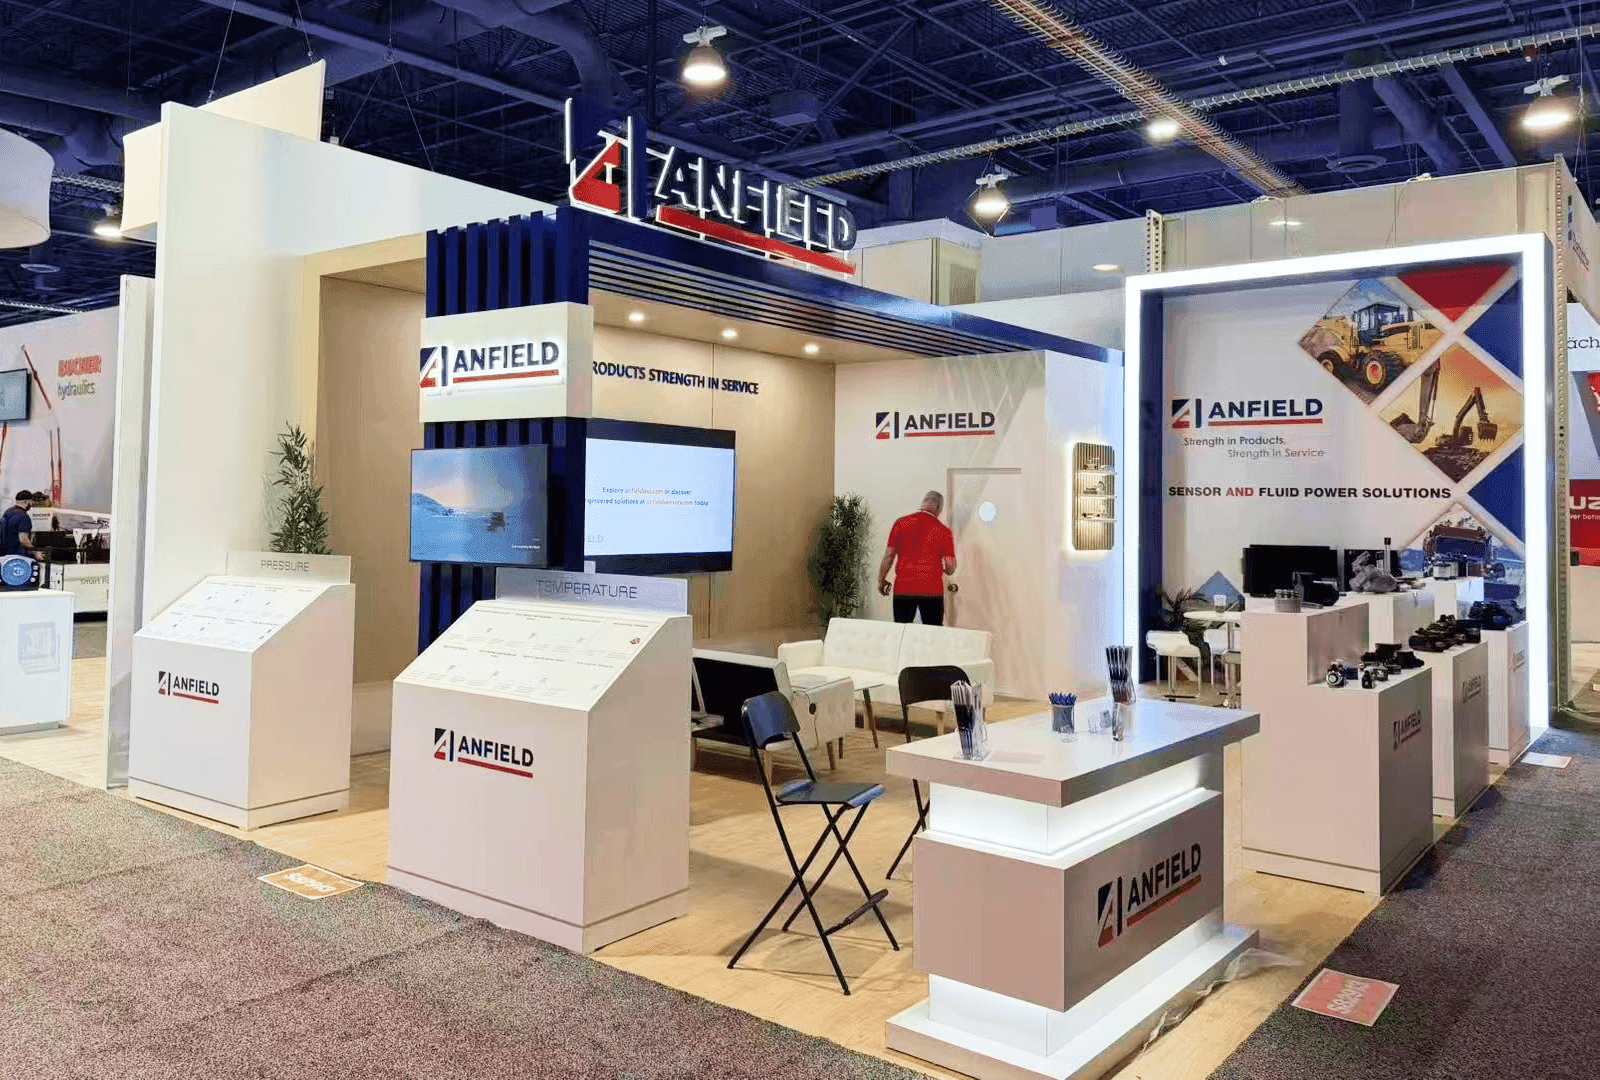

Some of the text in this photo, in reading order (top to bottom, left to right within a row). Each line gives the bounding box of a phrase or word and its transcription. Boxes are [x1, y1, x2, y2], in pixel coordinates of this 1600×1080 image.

[650, 146, 857, 252] ANFIELD
[453, 341, 560, 373] ANFIELD
[649, 368, 705, 388] STRENGTH
[708, 376, 719, 390] IN
[721, 378, 759, 395] SERVICE
[1208, 398, 1323, 418] ANFIELD
[904, 411, 996, 430] ANFIELD
[1227, 437, 1236, 445] in
[1228, 449, 1269, 460] Strength
[1284, 448, 1325, 457] Service
[1168, 487, 1451, 498] SENSOR AND FLUID POWER SOLUTIONS
[260, 559, 310, 572] PRESSURE
[536, 580, 638, 599] TEMPERATURE
[173, 676, 220, 696] ANFIELD
[458, 735, 534, 767] ANFIELD
[1127, 843, 1201, 912] ANFIELD
